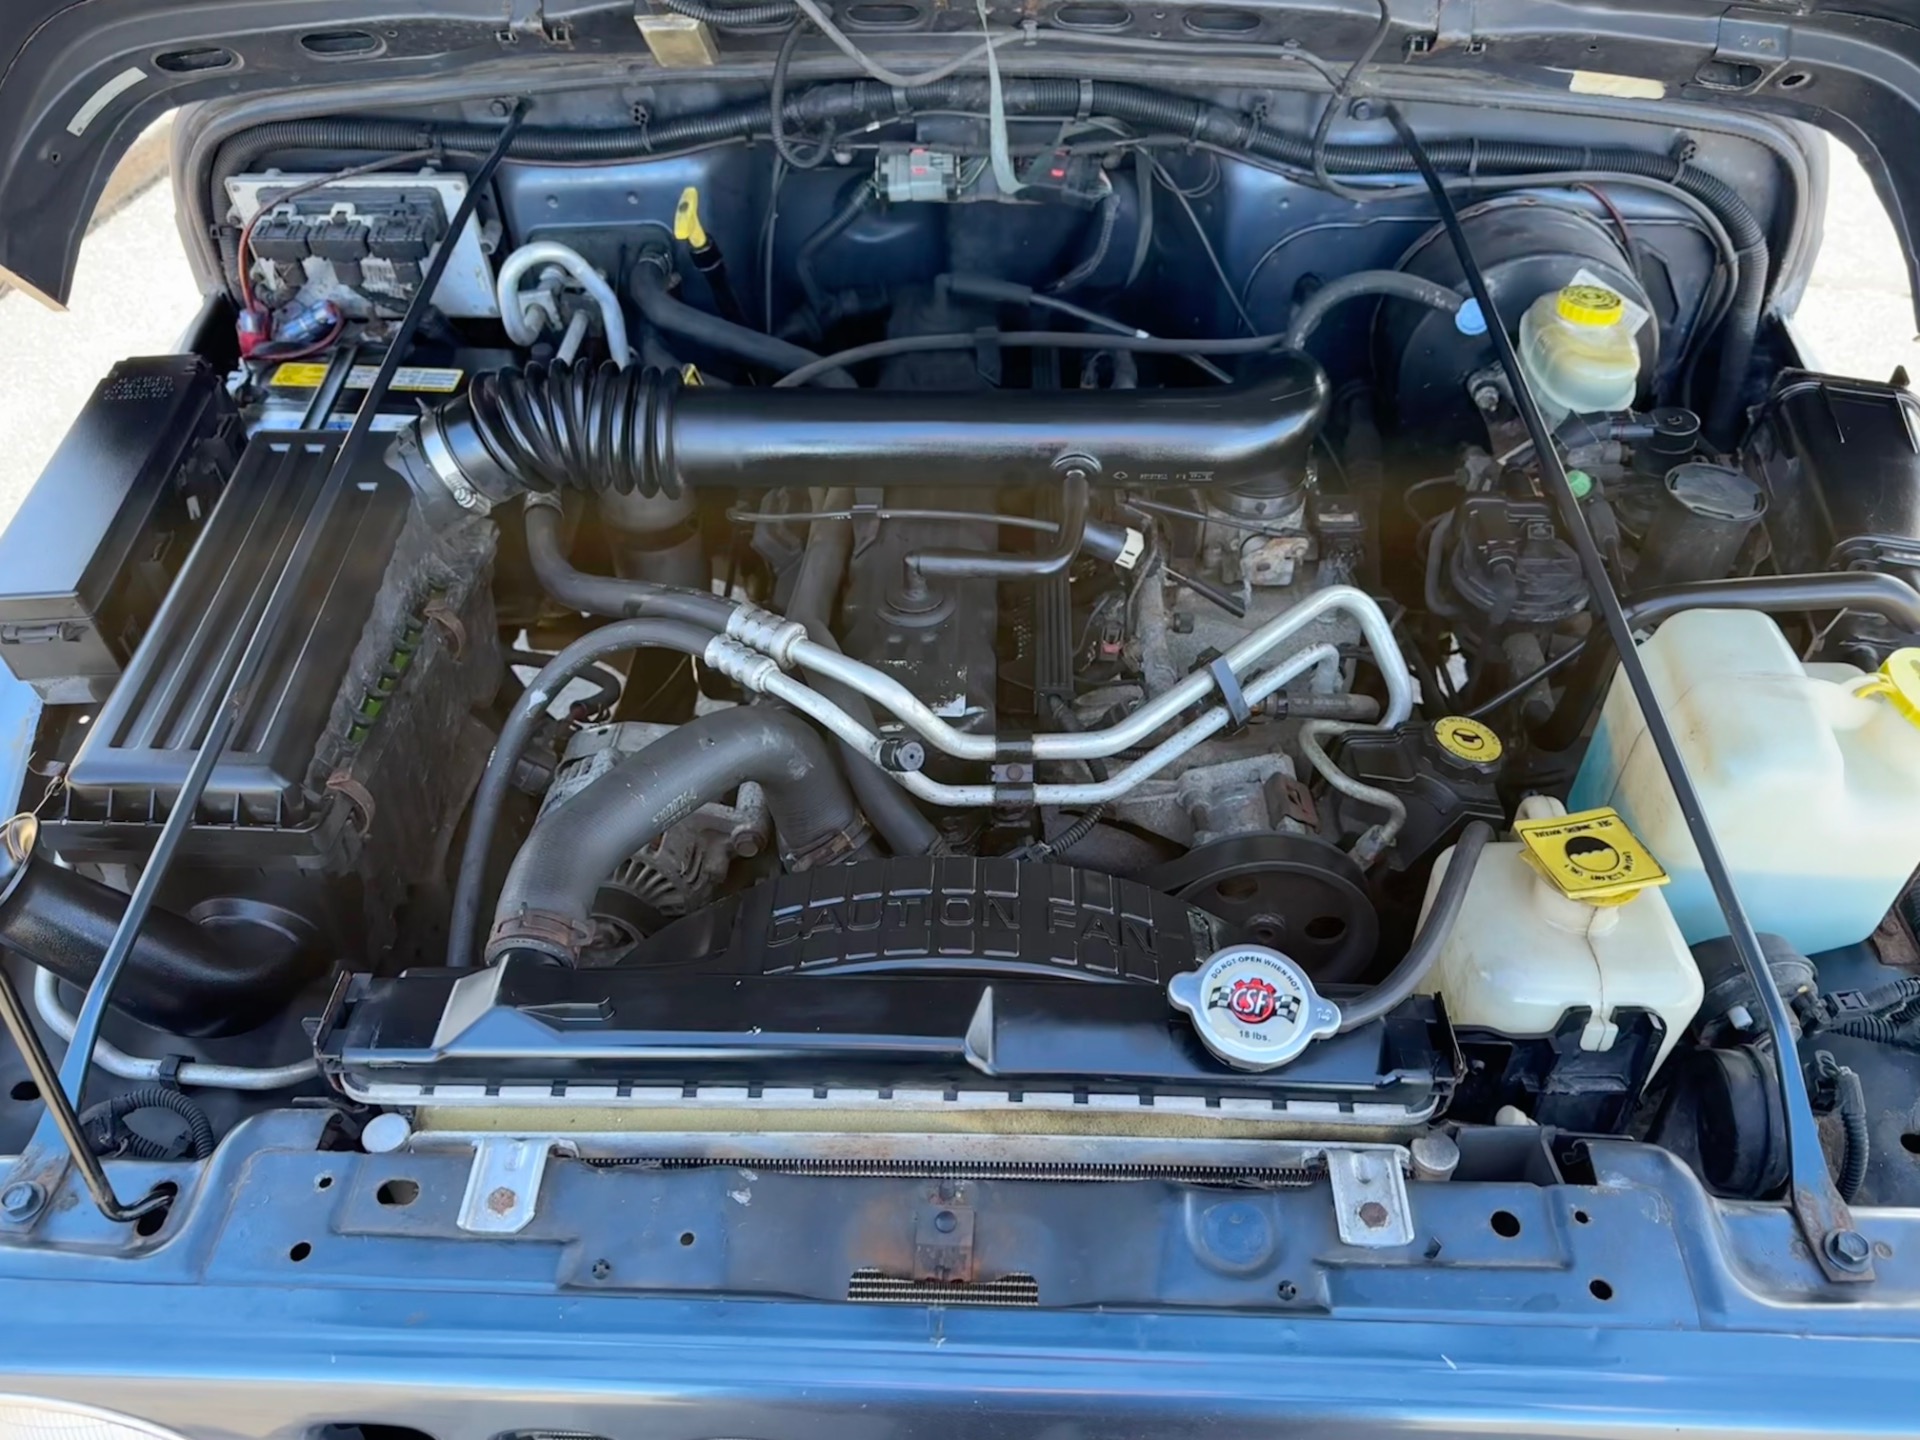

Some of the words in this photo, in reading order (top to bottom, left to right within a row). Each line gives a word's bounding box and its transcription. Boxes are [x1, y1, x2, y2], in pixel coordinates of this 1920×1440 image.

[767, 896, 1020, 948] CAUTION
[1049, 905, 1159, 955] FAN
[1211, 968, 1222, 980] DO
[1221, 958, 1237, 970] NOT
[1238, 956, 1263, 964] OPEN
[1264, 959, 1288, 977] WHEN
[1286, 974, 1301, 992] HOT
[1232, 987, 1268, 1015] CSF
[1239, 1030, 1251, 1039] 18
[1252, 1031, 1272, 1042] lbs.
